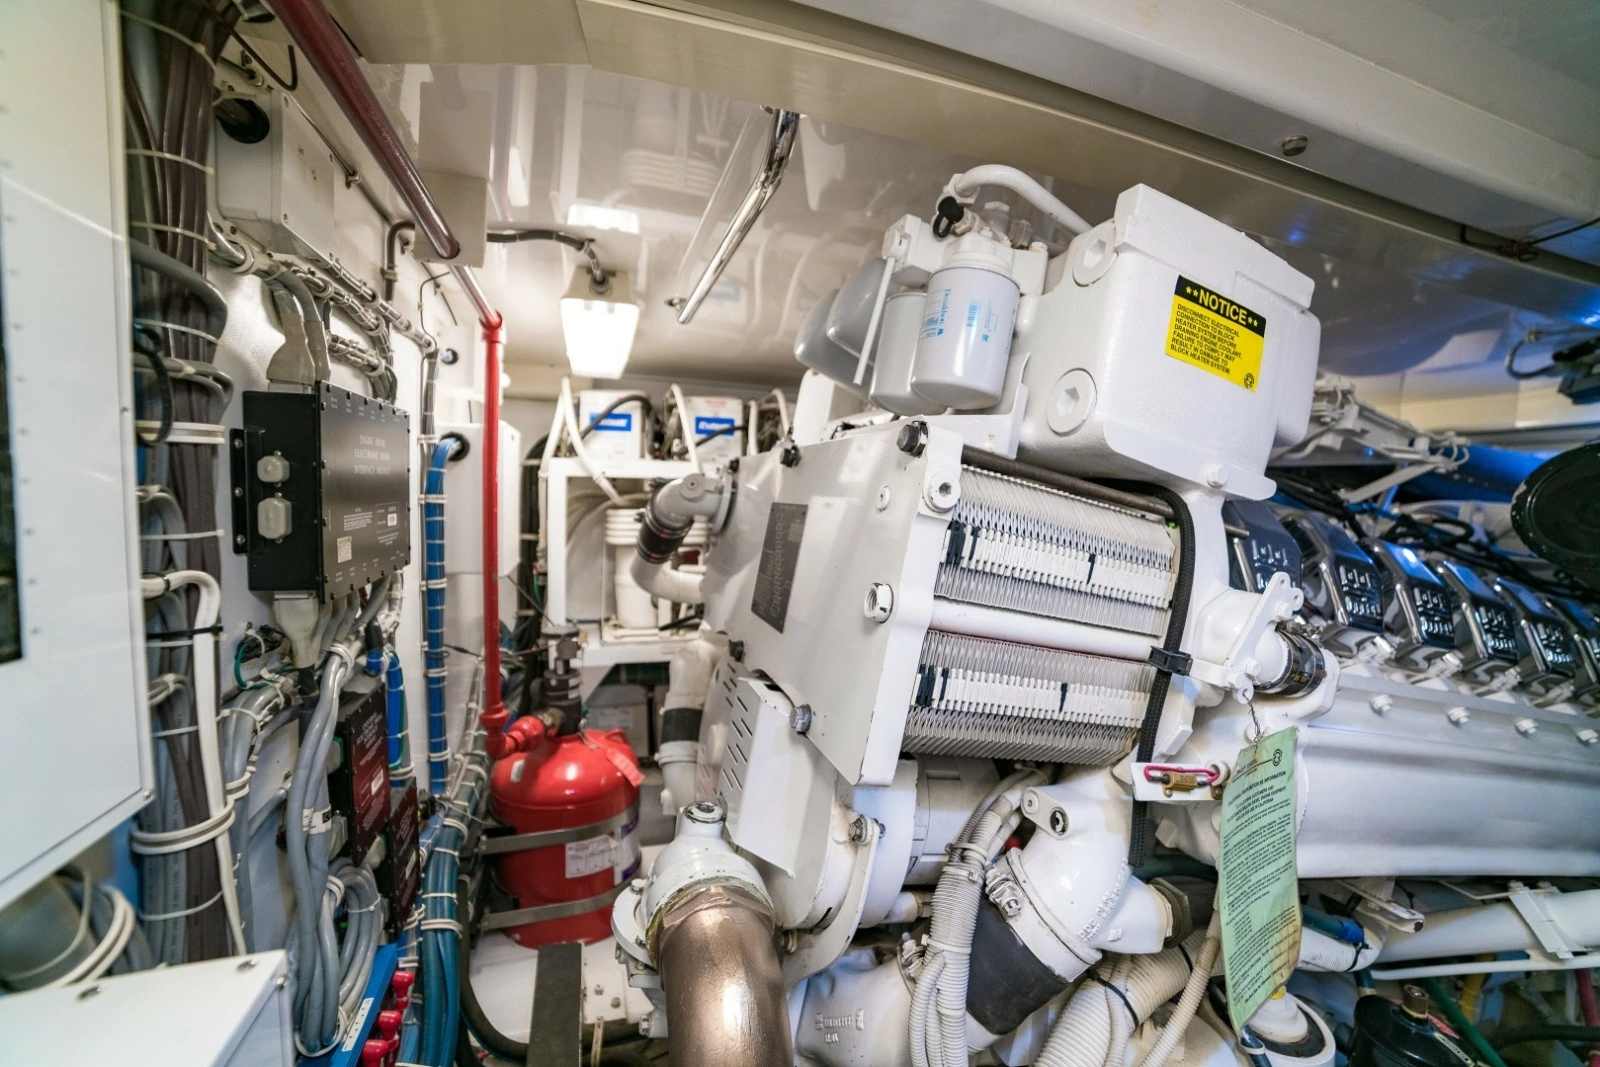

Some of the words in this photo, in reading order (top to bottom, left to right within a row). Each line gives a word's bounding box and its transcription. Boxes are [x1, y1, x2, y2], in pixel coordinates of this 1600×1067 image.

[1176, 311, 1210, 329] CONNECTION
[1218, 328, 1235, 341] BLOCK
[1176, 318, 1197, 332] HEATER
[1198, 326, 1217, 340] SYSTEM
[1217, 334, 1237, 349] BEFORE
[1178, 304, 1211, 323] DISCONNECT
[1211, 318, 1240, 337] ELECTRICAL
[1173, 331, 1195, 344] FAILURE
[1204, 342, 1224, 357] COMPLY
[1224, 352, 1236, 362] MAY
[1174, 324, 1199, 338] DRAINING
[1200, 333, 1219, 347] ENGINE
[1171, 344, 1189, 356] BLOCK
[1190, 351, 1210, 365] HEATER
[1172, 338, 1192, 351] RESULT
[1200, 348, 1220, 362] DAMAGE
[1221, 358, 1228, 366] TO
[1264, 771, 1286, 783] INFORMATION
[1252, 788, 1267, 798] CUSTOMERS
